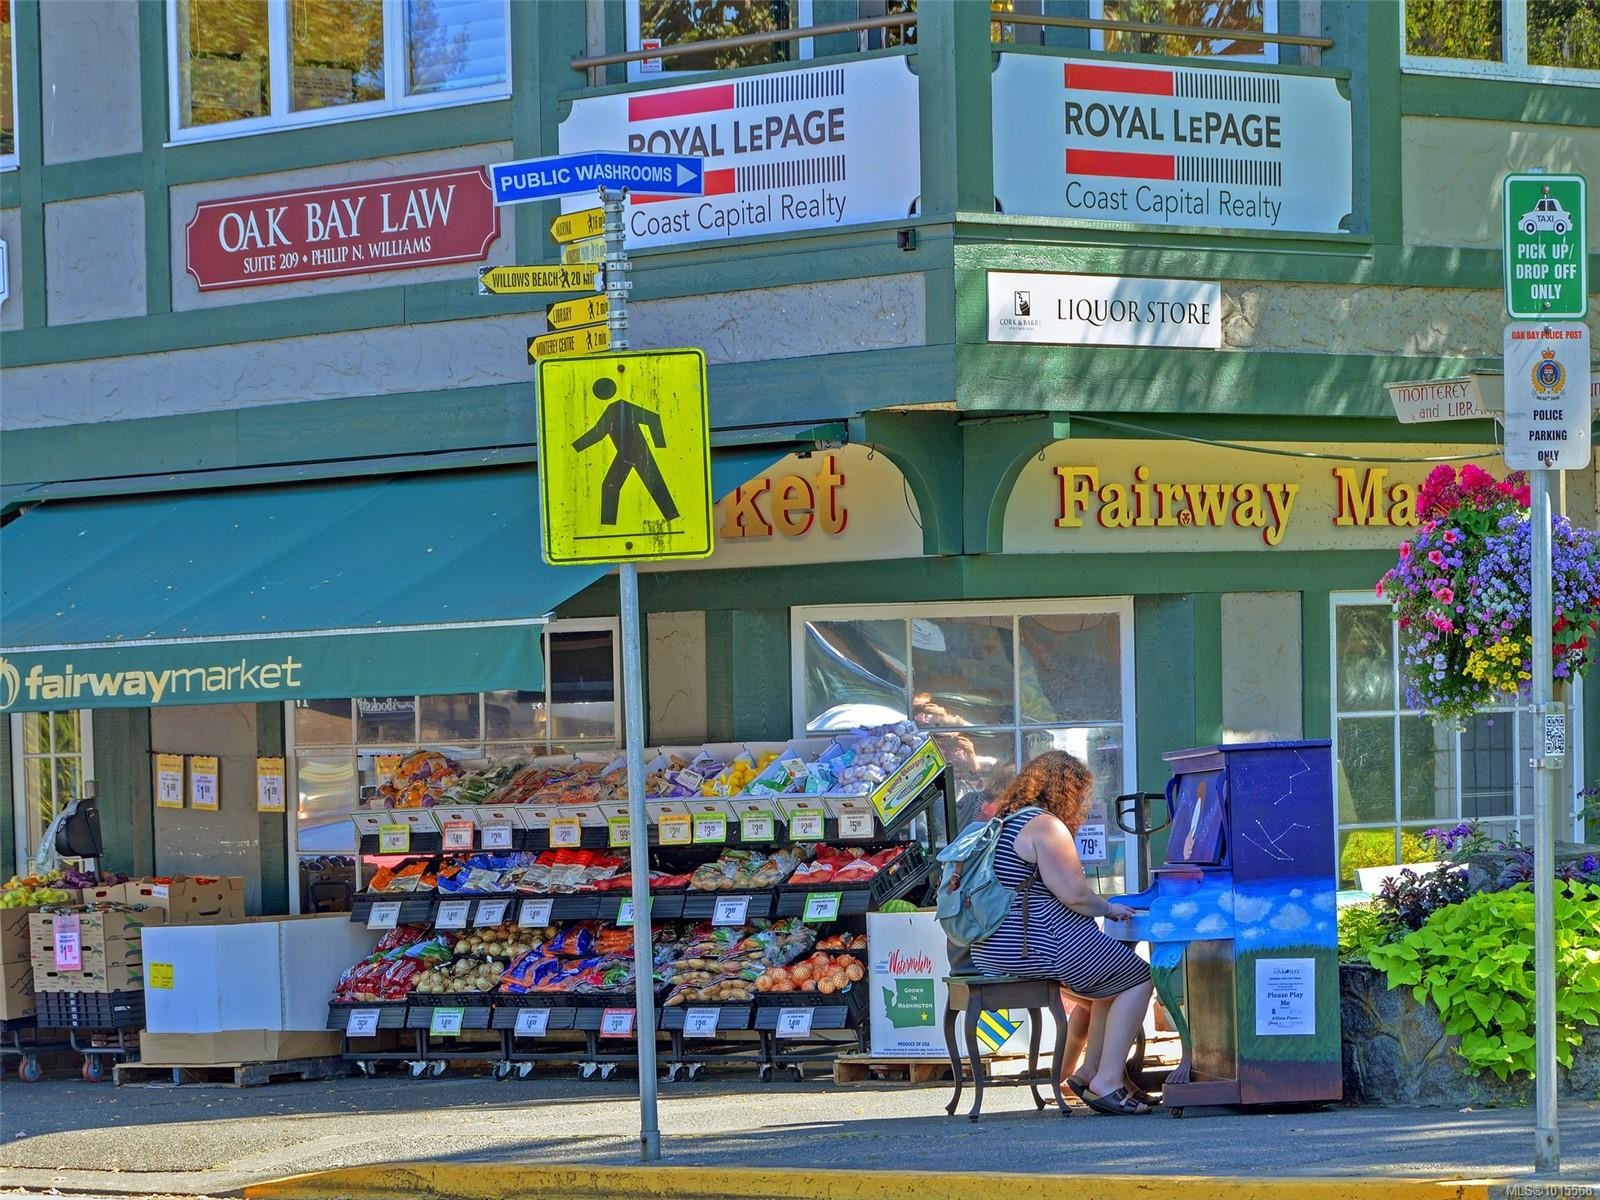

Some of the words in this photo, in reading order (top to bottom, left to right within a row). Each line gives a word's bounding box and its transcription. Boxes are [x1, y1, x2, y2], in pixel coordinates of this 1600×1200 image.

[1065, 101, 1164, 141] ROYAL
[501, 168, 571, 192] PUBLIC
[575, 163, 672, 182] WASHROOMS
[1065, 181, 1128, 211] Coast
[1136, 185, 1209, 222] Capital
[1219, 190, 1282, 226] Realty
[219, 206, 292, 253] OAK
[305, 196, 366, 243] BAY
[380, 185, 456, 234] LAW
[631, 207, 690, 238] Coast
[697, 195, 771, 233] Capital
[782, 189, 846, 222] Realty
[243, 254, 276, 274] SUITE
[279, 251, 299, 270] 209
[311, 247, 348, 266] PHILIP
[352, 244, 365, 260] N.
[368, 236, 431, 259] WILLIAMS
[1517, 243, 1547, 259] PICK
[1552, 243, 1575, 260] UP/
[492, 273, 530, 288] WILLOWS
[532, 272, 559, 287] BEACH
[571, 271, 581, 285] 20
[1516, 263, 1549, 279] DROP
[1554, 263, 1577, 279] OFF
[1530, 284, 1562, 299] ONLY
[553, 307, 572, 323] LIBRARY
[1057, 299, 1141, 326] LIQUOR
[1146, 301, 1211, 325] STORE
[1511, 331, 1525, 340] OAK
[1526, 331, 1539, 340] BAY
[1540, 330, 1563, 340] POLICE
[1565, 330, 1582, 339] POST
[536, 338, 559, 356] MONTEREY
[559, 336, 575, 352] CENTRE
[1398, 383, 1469, 403] MONTEREY
[1419, 404, 1440, 419] and
[1533, 409, 1563, 421] POLICE
[1529, 430, 1567, 441] PARKING
[1537, 450, 1560, 461] ONLY
[1053, 465, 1299, 546] Fairway
